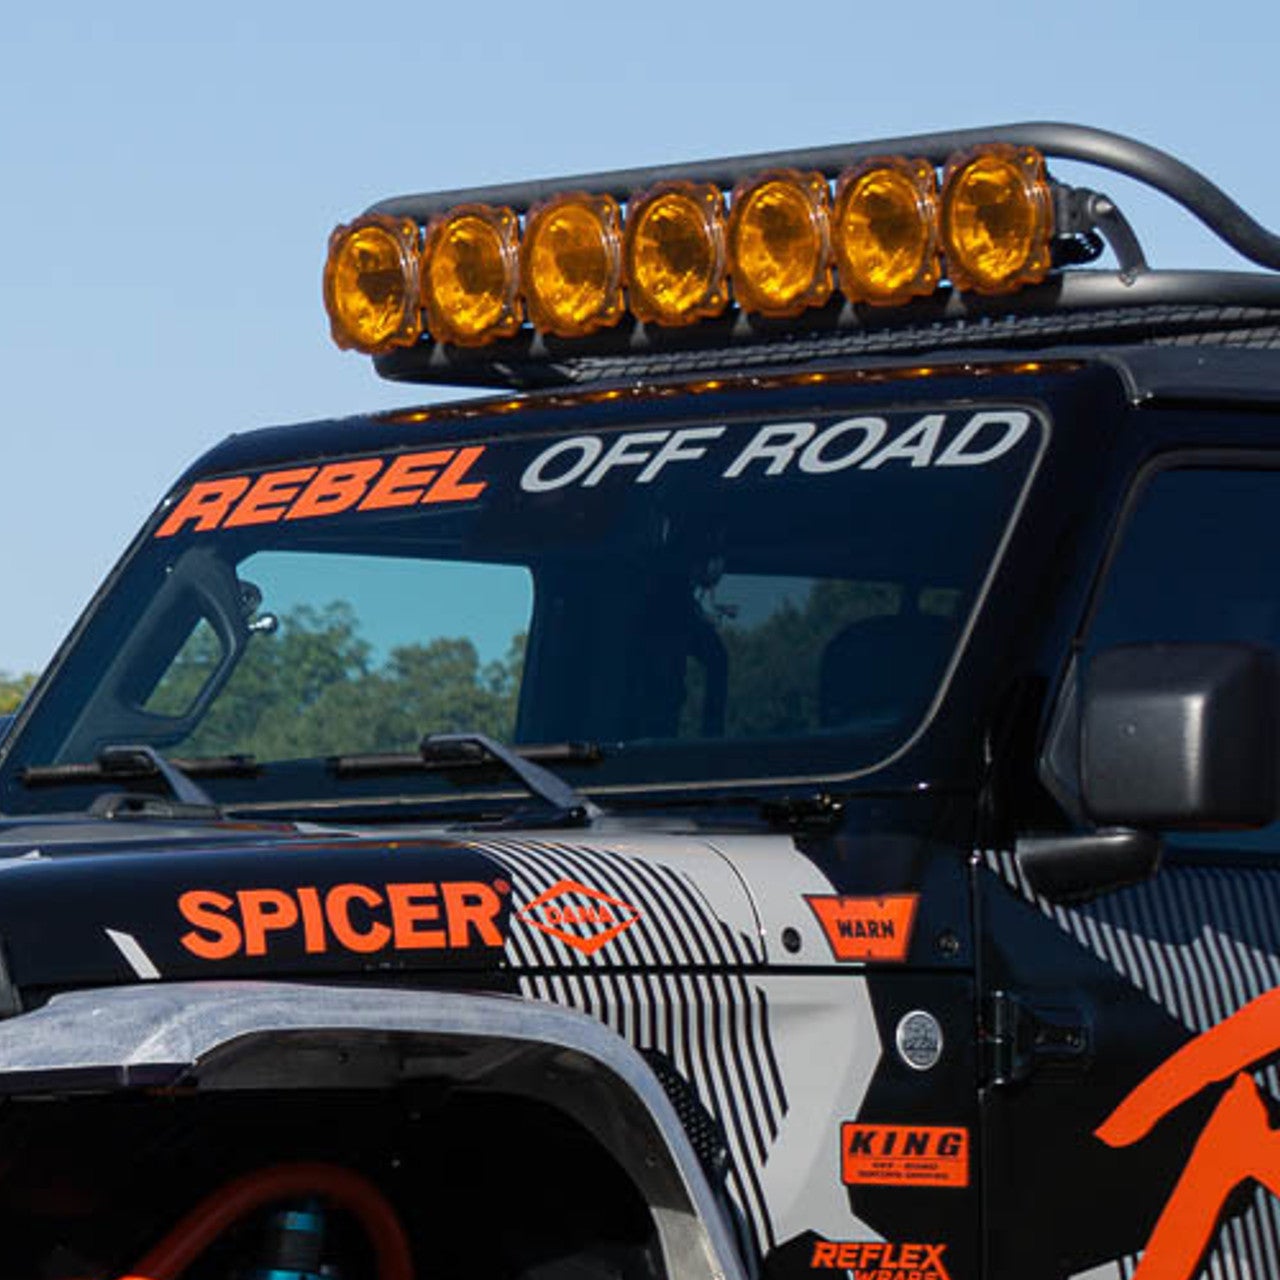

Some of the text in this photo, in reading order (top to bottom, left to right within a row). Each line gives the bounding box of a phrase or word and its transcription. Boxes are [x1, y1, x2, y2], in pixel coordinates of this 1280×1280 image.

[153, 411, 1031, 538] REBEL OFF ROAD
[543, 904, 616, 925] DANA
[836, 919, 895, 939] WARN
[849, 1130, 963, 1156] KING
